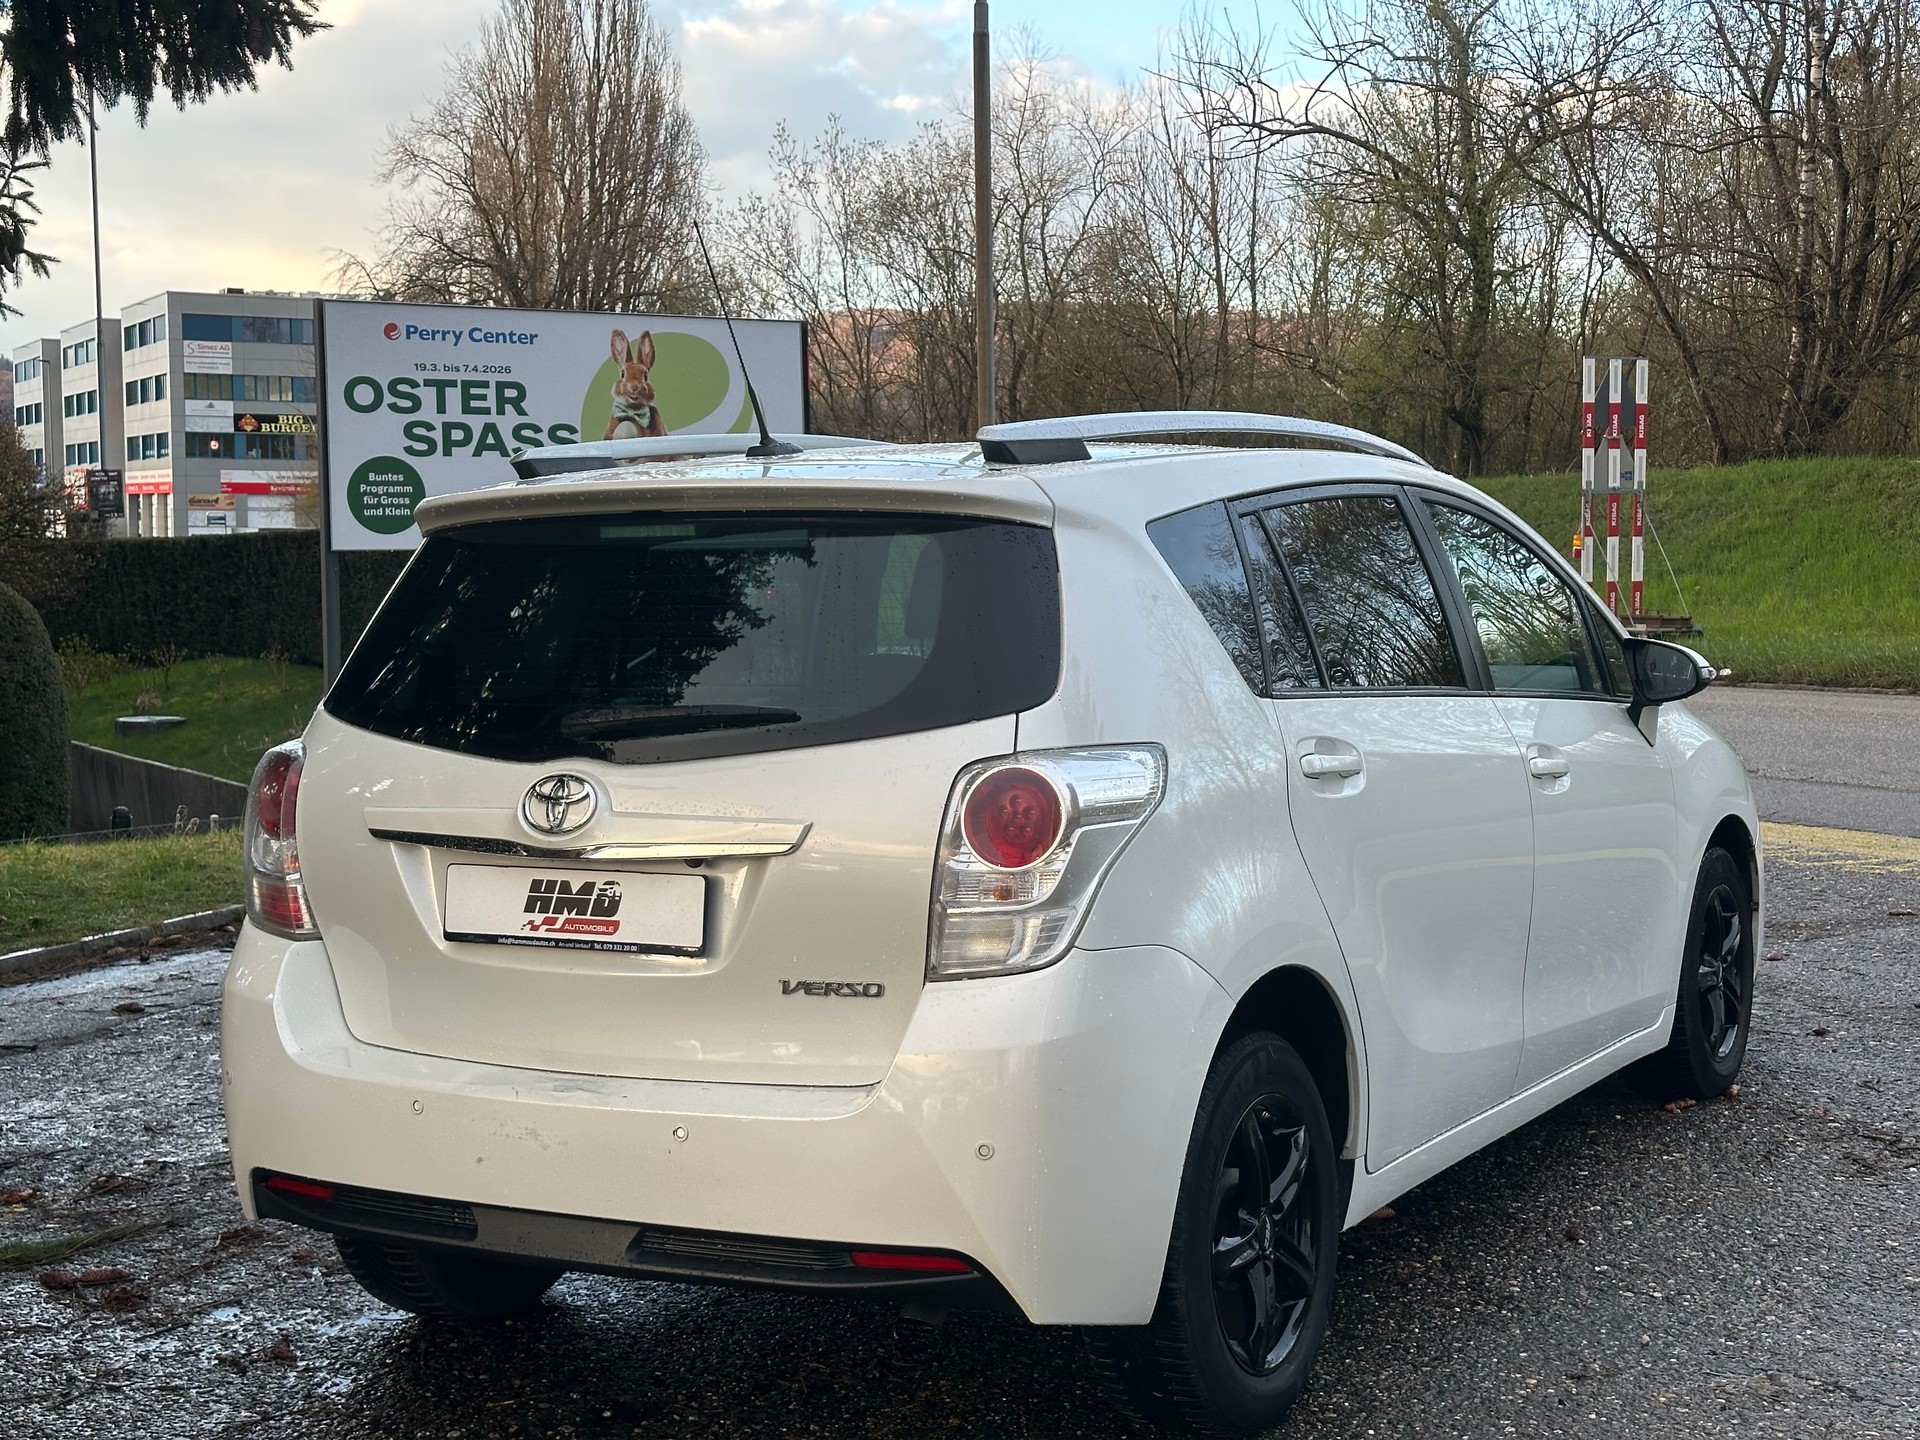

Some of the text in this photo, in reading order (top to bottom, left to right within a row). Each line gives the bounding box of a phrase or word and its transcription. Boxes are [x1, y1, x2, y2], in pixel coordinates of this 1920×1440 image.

[405, 324, 539, 346] Perry Center
[413, 363, 512, 374] 19.3. bis 7.4.2026
[343, 375, 529, 417] OSTER
[278, 415, 304, 424] BIG
[402, 420, 579, 458] SPASS
[368, 472, 404, 481] Buntes
[360, 484, 413, 494] Programm
[363, 495, 410, 504] für Gross
[363, 507, 411, 516] und Klein
[523, 878, 622, 918] HMD
[563, 923, 615, 933] AUTOMOBILE
[778, 978, 885, 998] VERSO
